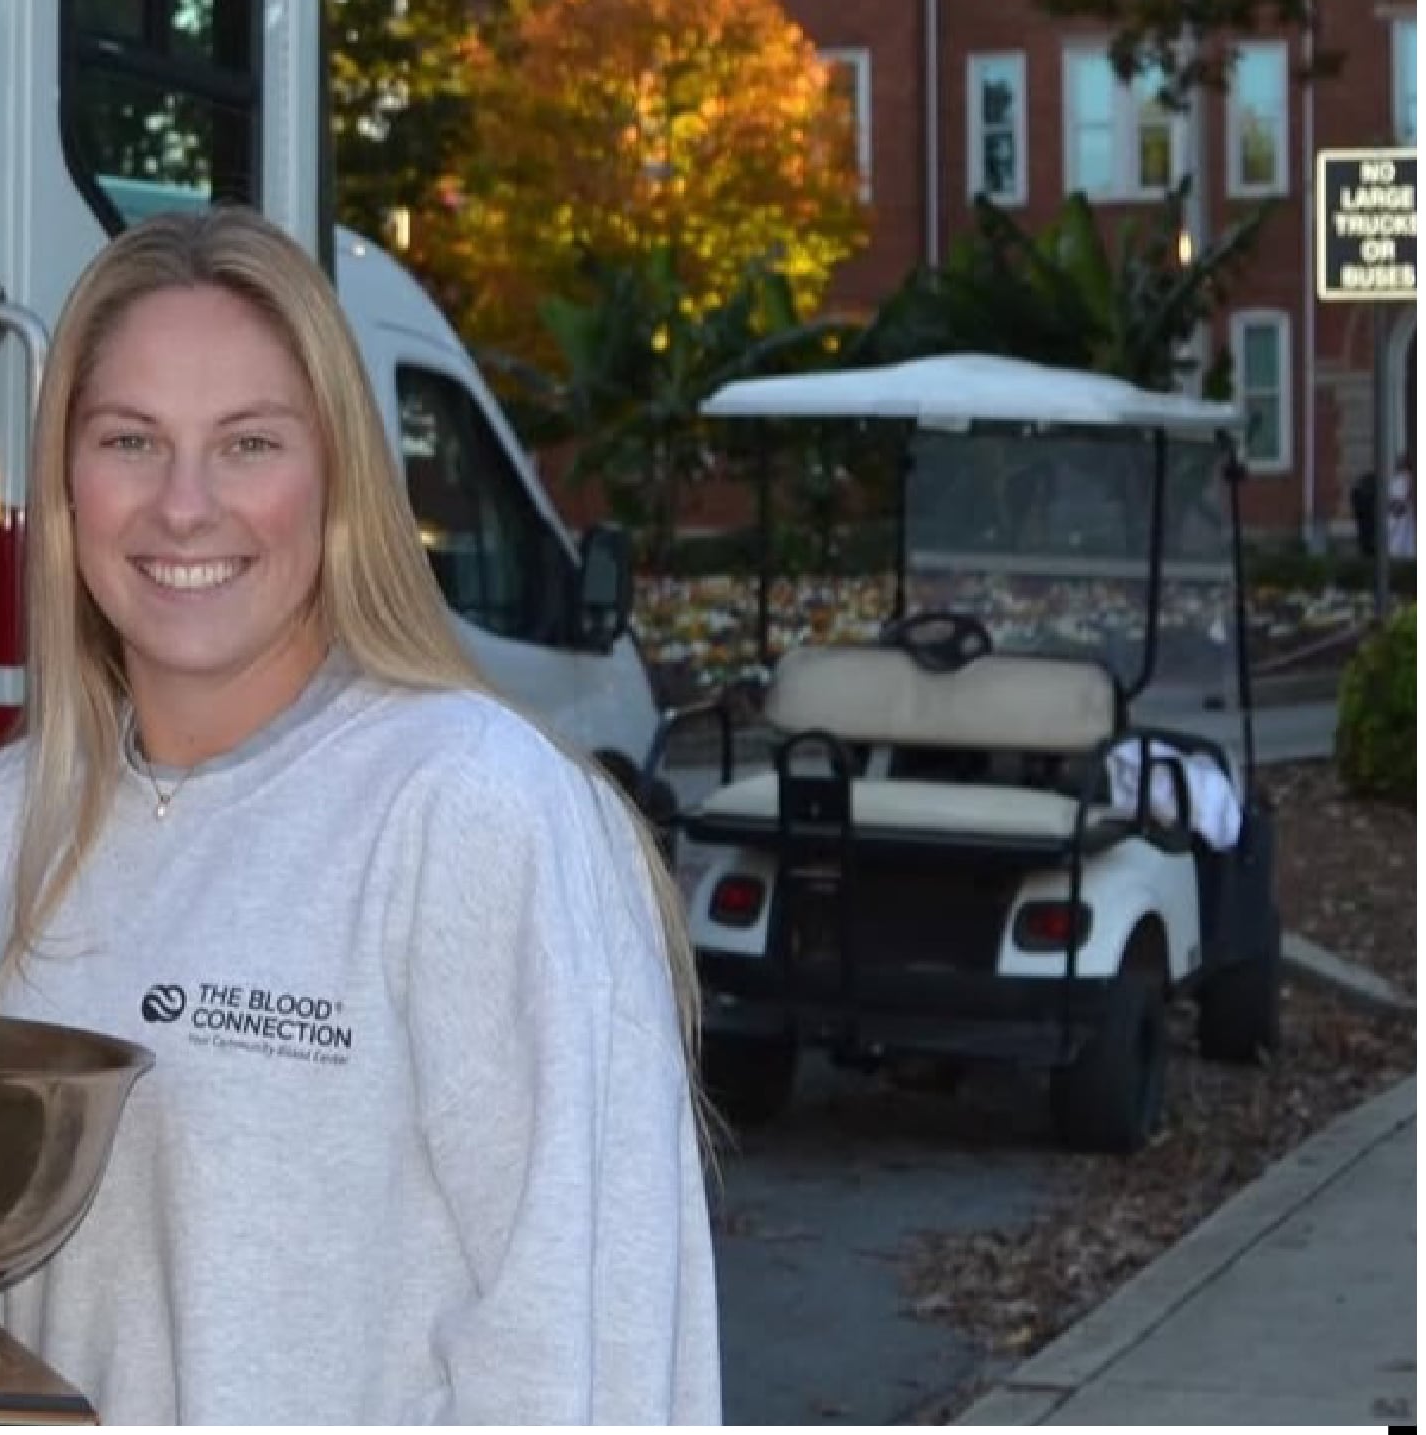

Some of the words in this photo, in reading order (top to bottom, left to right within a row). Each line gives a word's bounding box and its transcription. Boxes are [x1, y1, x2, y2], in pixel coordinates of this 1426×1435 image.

[1360, 161, 1396, 183] NO
[1340, 185, 1415, 210] LARGE
[1360, 239, 1396, 262] OR
[1340, 263, 1416, 288] BUSES
[199, 983, 244, 1008] THE
[248, 990, 333, 1020] BLOOD
[191, 1008, 352, 1048] CONNECTION
